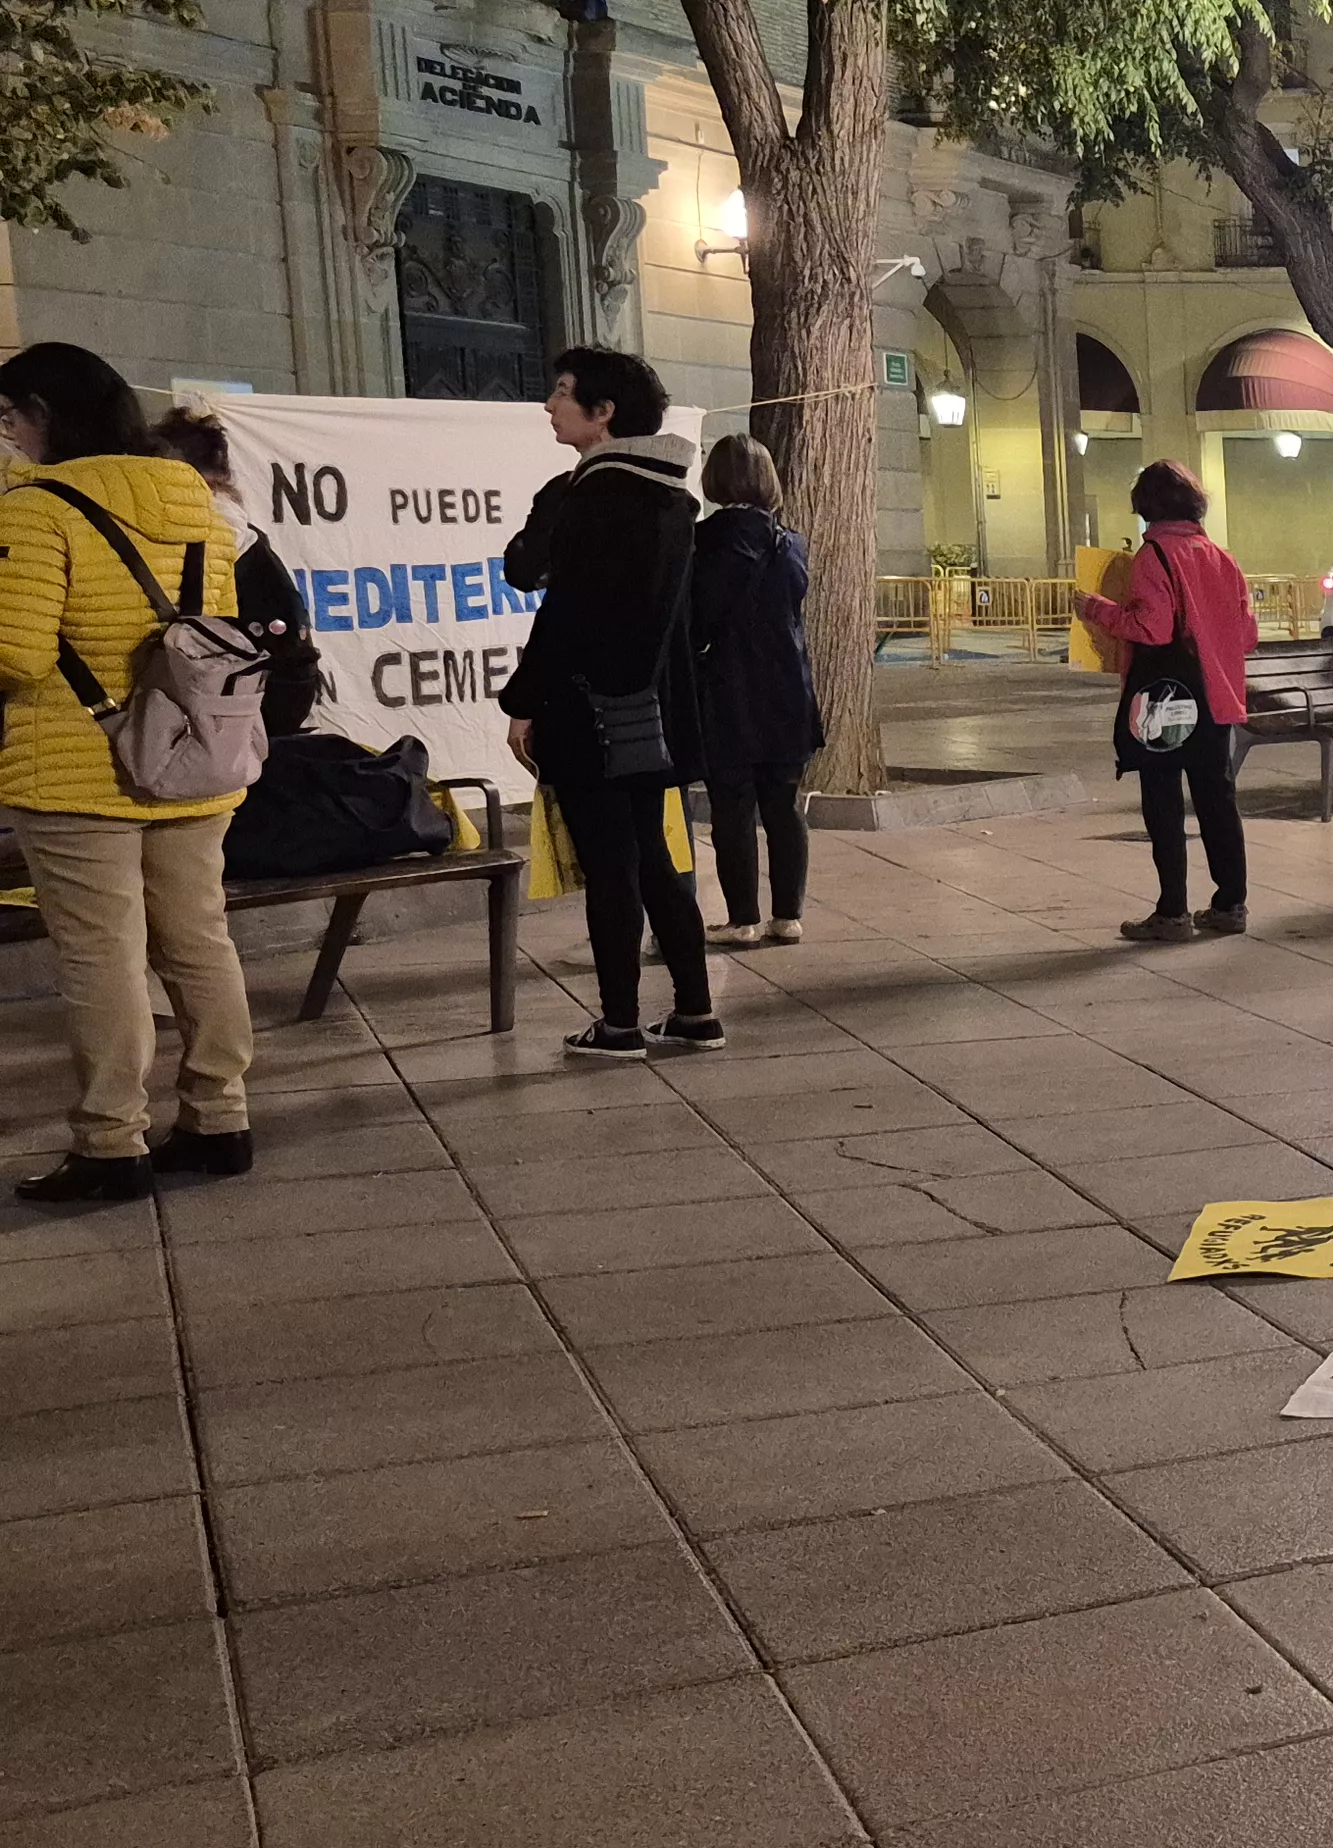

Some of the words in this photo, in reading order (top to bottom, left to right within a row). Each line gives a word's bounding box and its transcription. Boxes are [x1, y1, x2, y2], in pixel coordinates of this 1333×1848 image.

[420, 81, 542, 126] ACIENDA
[270, 461, 348, 526] NO
[389, 487, 503, 525] PUEDE
